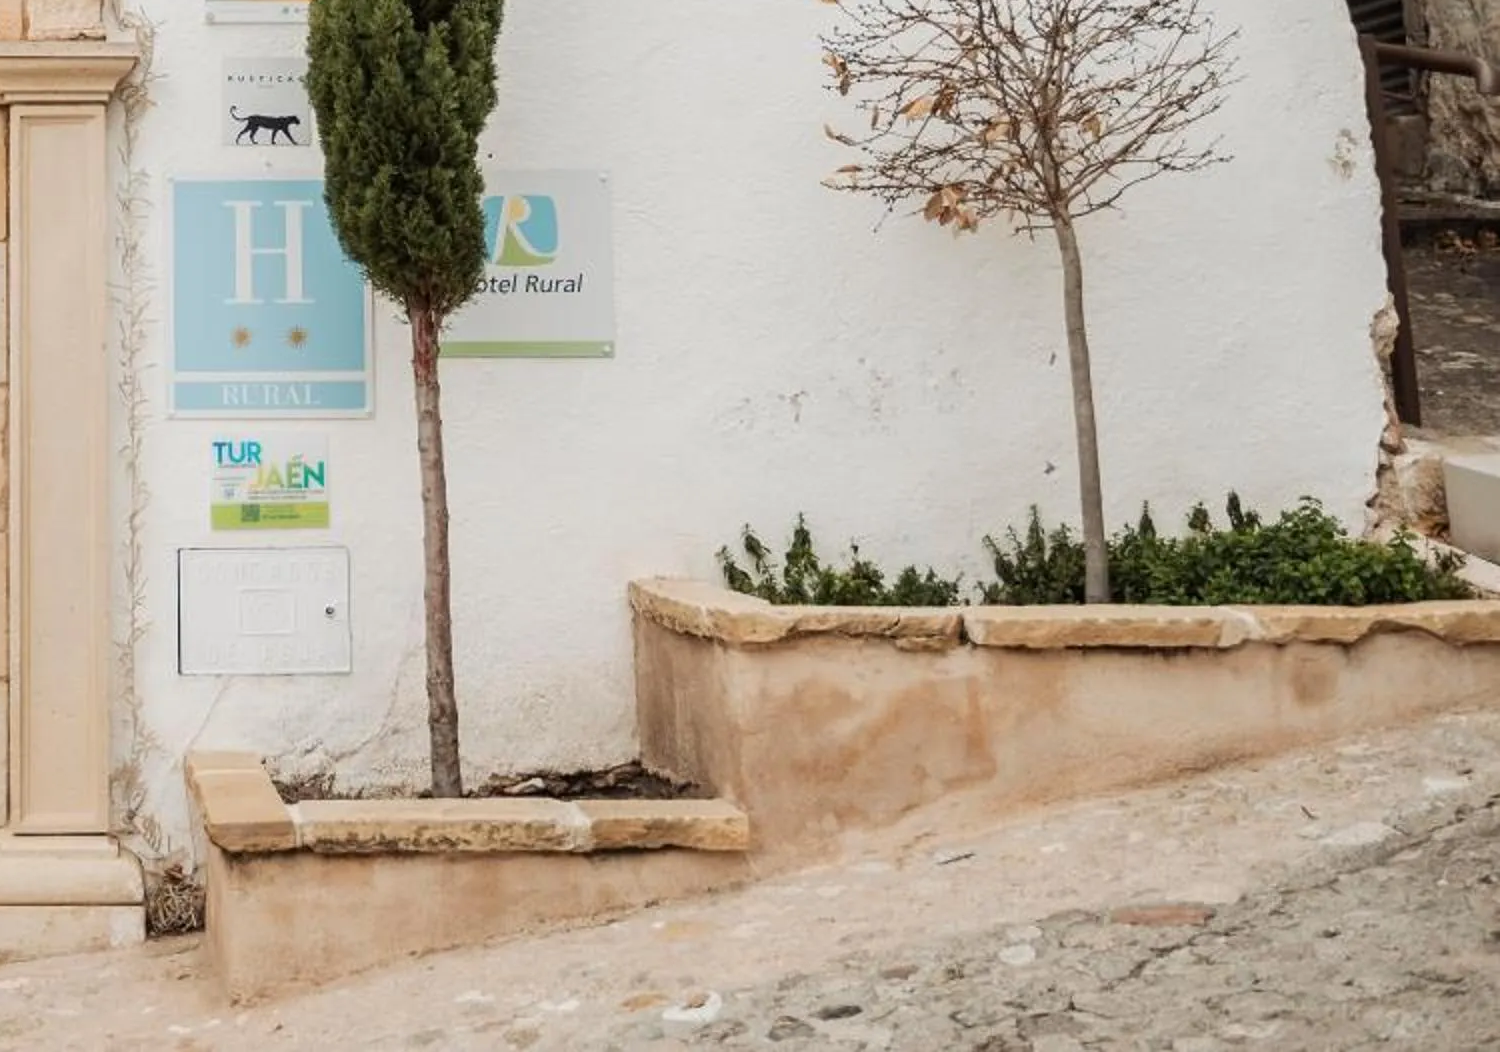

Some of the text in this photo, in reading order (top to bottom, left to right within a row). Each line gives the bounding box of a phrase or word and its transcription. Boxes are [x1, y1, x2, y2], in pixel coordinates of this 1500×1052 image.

[222, 200, 316, 304] H
[474, 272, 583, 293] otel Rural
[221, 384, 321, 405] RURAL
[212, 441, 261, 464] TUR
[250, 453, 325, 489] JAÉN
